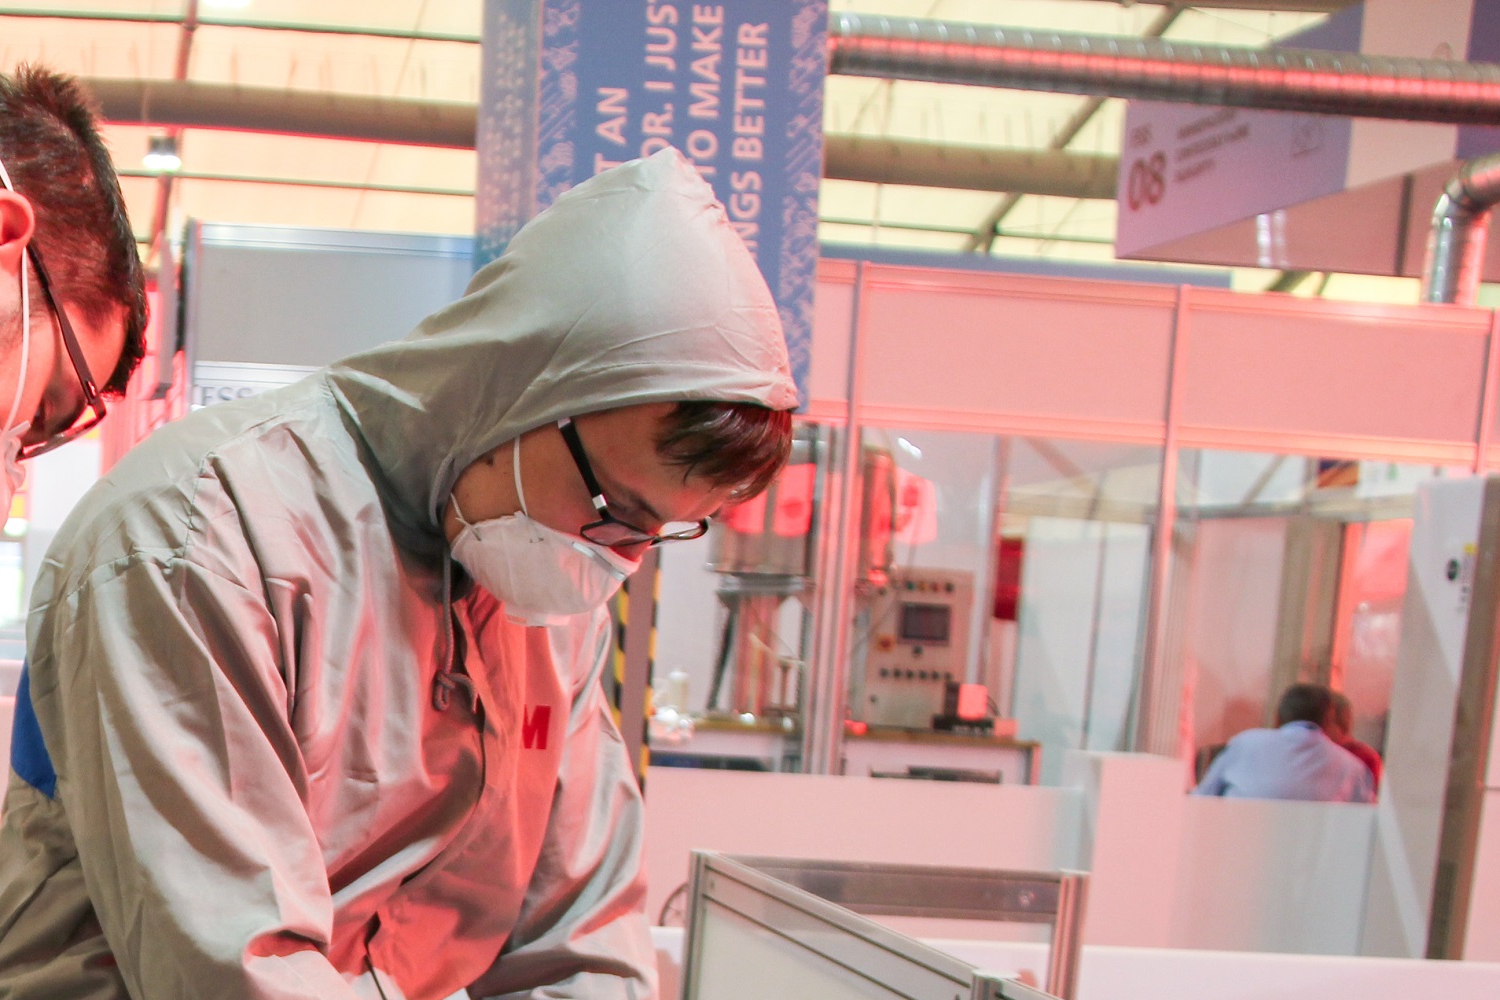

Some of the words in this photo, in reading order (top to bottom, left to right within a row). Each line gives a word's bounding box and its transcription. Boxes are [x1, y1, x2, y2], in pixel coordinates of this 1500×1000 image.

[595, 87, 629, 146] AN
[688, 4, 725, 118] MAKE
[732, 22, 769, 160] BETTER
